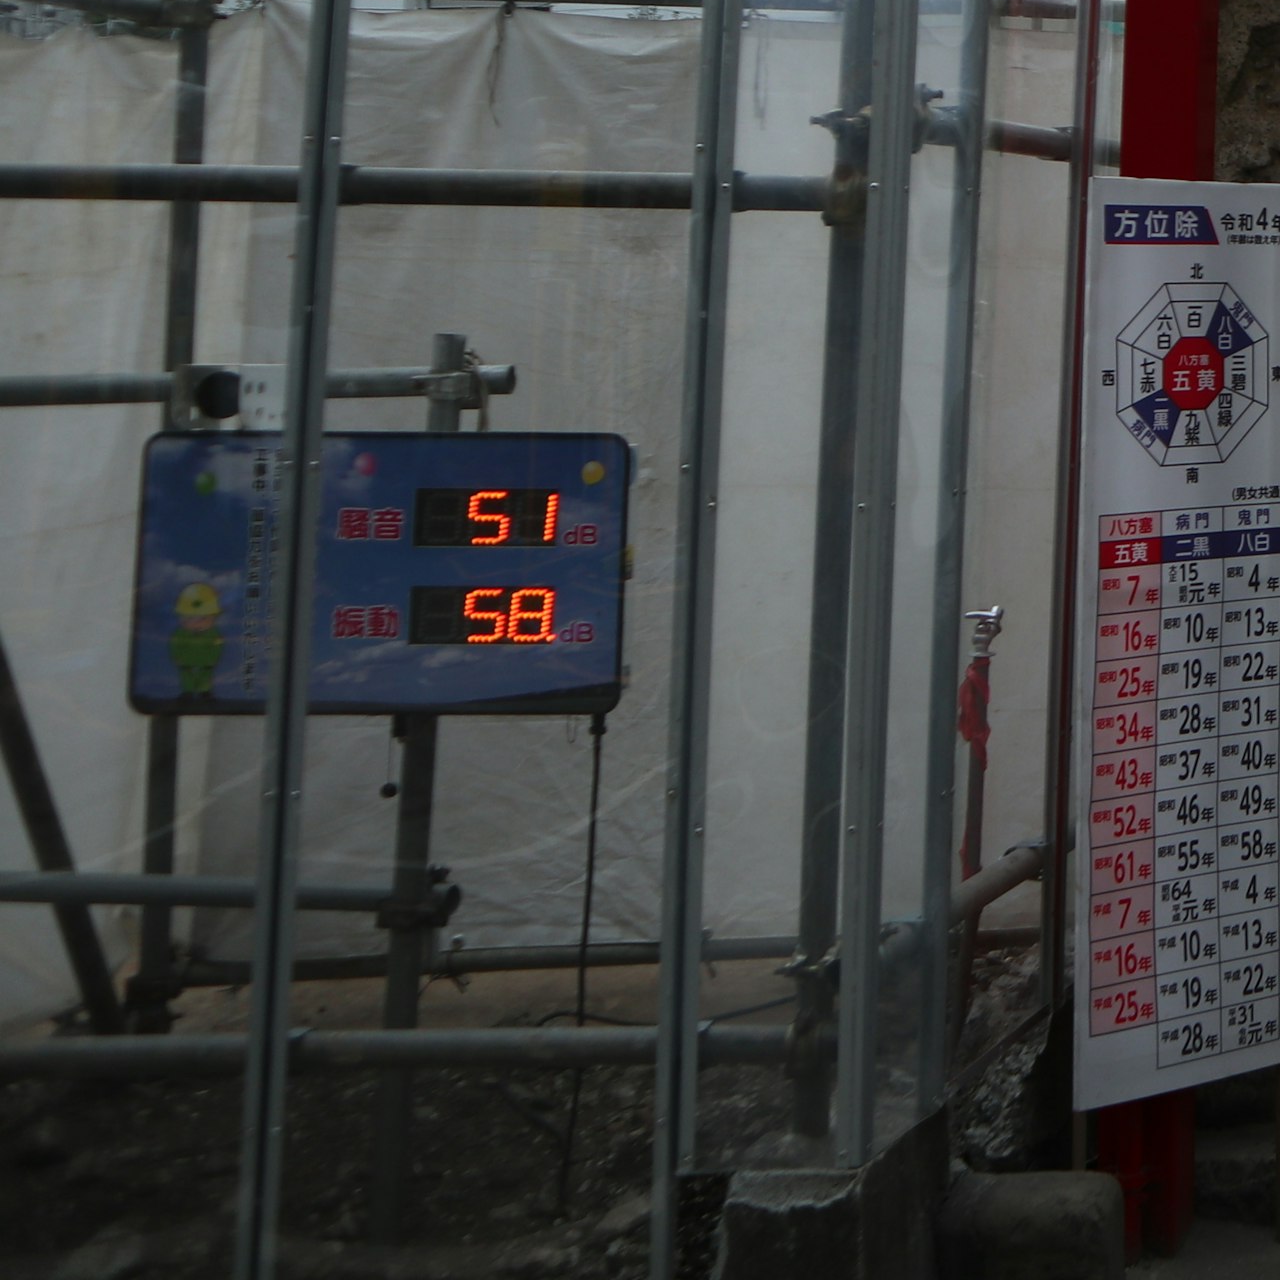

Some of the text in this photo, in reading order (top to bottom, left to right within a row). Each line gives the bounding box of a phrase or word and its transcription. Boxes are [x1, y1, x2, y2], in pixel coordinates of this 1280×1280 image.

[1113, 209, 1199, 240] 方位除
[1190, 263, 1203, 279] 北
[1229, 299, 1254, 330] 鬼門
[1157, 314, 1172, 350] 六白
[1218, 315, 1232, 350] 八白
[1102, 369, 1115, 386] 西
[1140, 358, 1156, 393] 七赤
[1172, 369, 1217, 392] 五黄
[1231, 354, 1246, 391] 三碧
[1218, 394, 1232, 427] 四緑
[1185, 412, 1200, 445] 九紫
[1186, 468, 1199, 484] 南
[335, 490, 599, 546] 騒音 51 dB
[1109, 508, 1270, 536] 八方塞 病門 鬼門
[1114, 532, 1270, 564] 五黄 二黒 八白
[331, 605, 399, 639] 振動
[559, 622, 594, 645] dB
